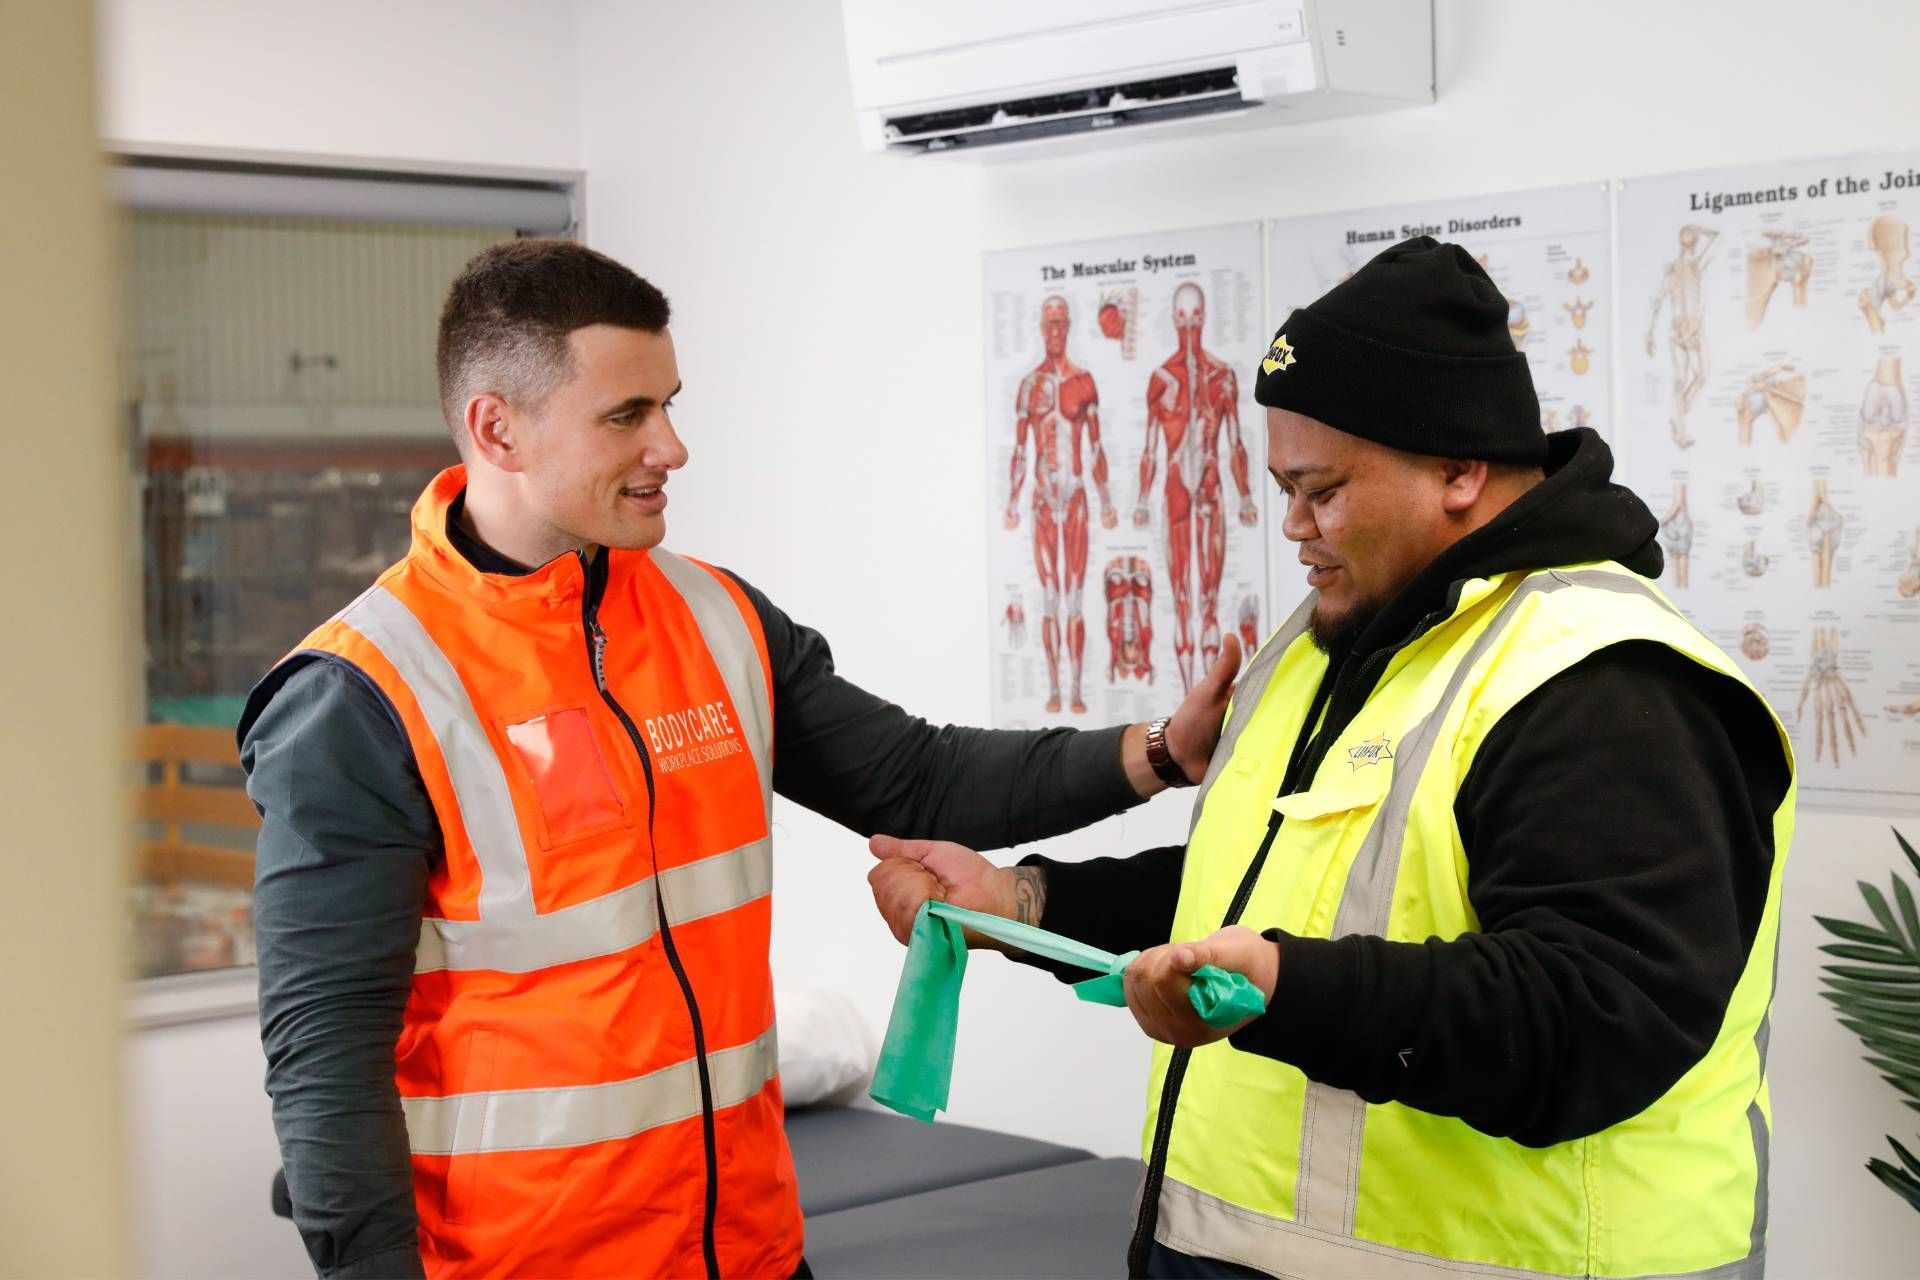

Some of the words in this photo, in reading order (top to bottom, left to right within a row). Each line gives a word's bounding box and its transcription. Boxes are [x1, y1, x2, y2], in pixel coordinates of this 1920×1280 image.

[1690, 184, 1798, 214] Ligaments
[1807, 178, 1828, 198] of
[1836, 176, 1870, 195] the
[1346, 230, 1396, 245] Human
[1448, 215, 1522, 234] Disorders
[1041, 265, 1066, 281] The
[1072, 258, 1137, 277] Muscular
[1143, 253, 1196, 274] System
[645, 701, 734, 753] BODYCARE
[657, 748, 703, 773] WORKPLACE
[701, 737, 743, 762] SOLUTIONS
